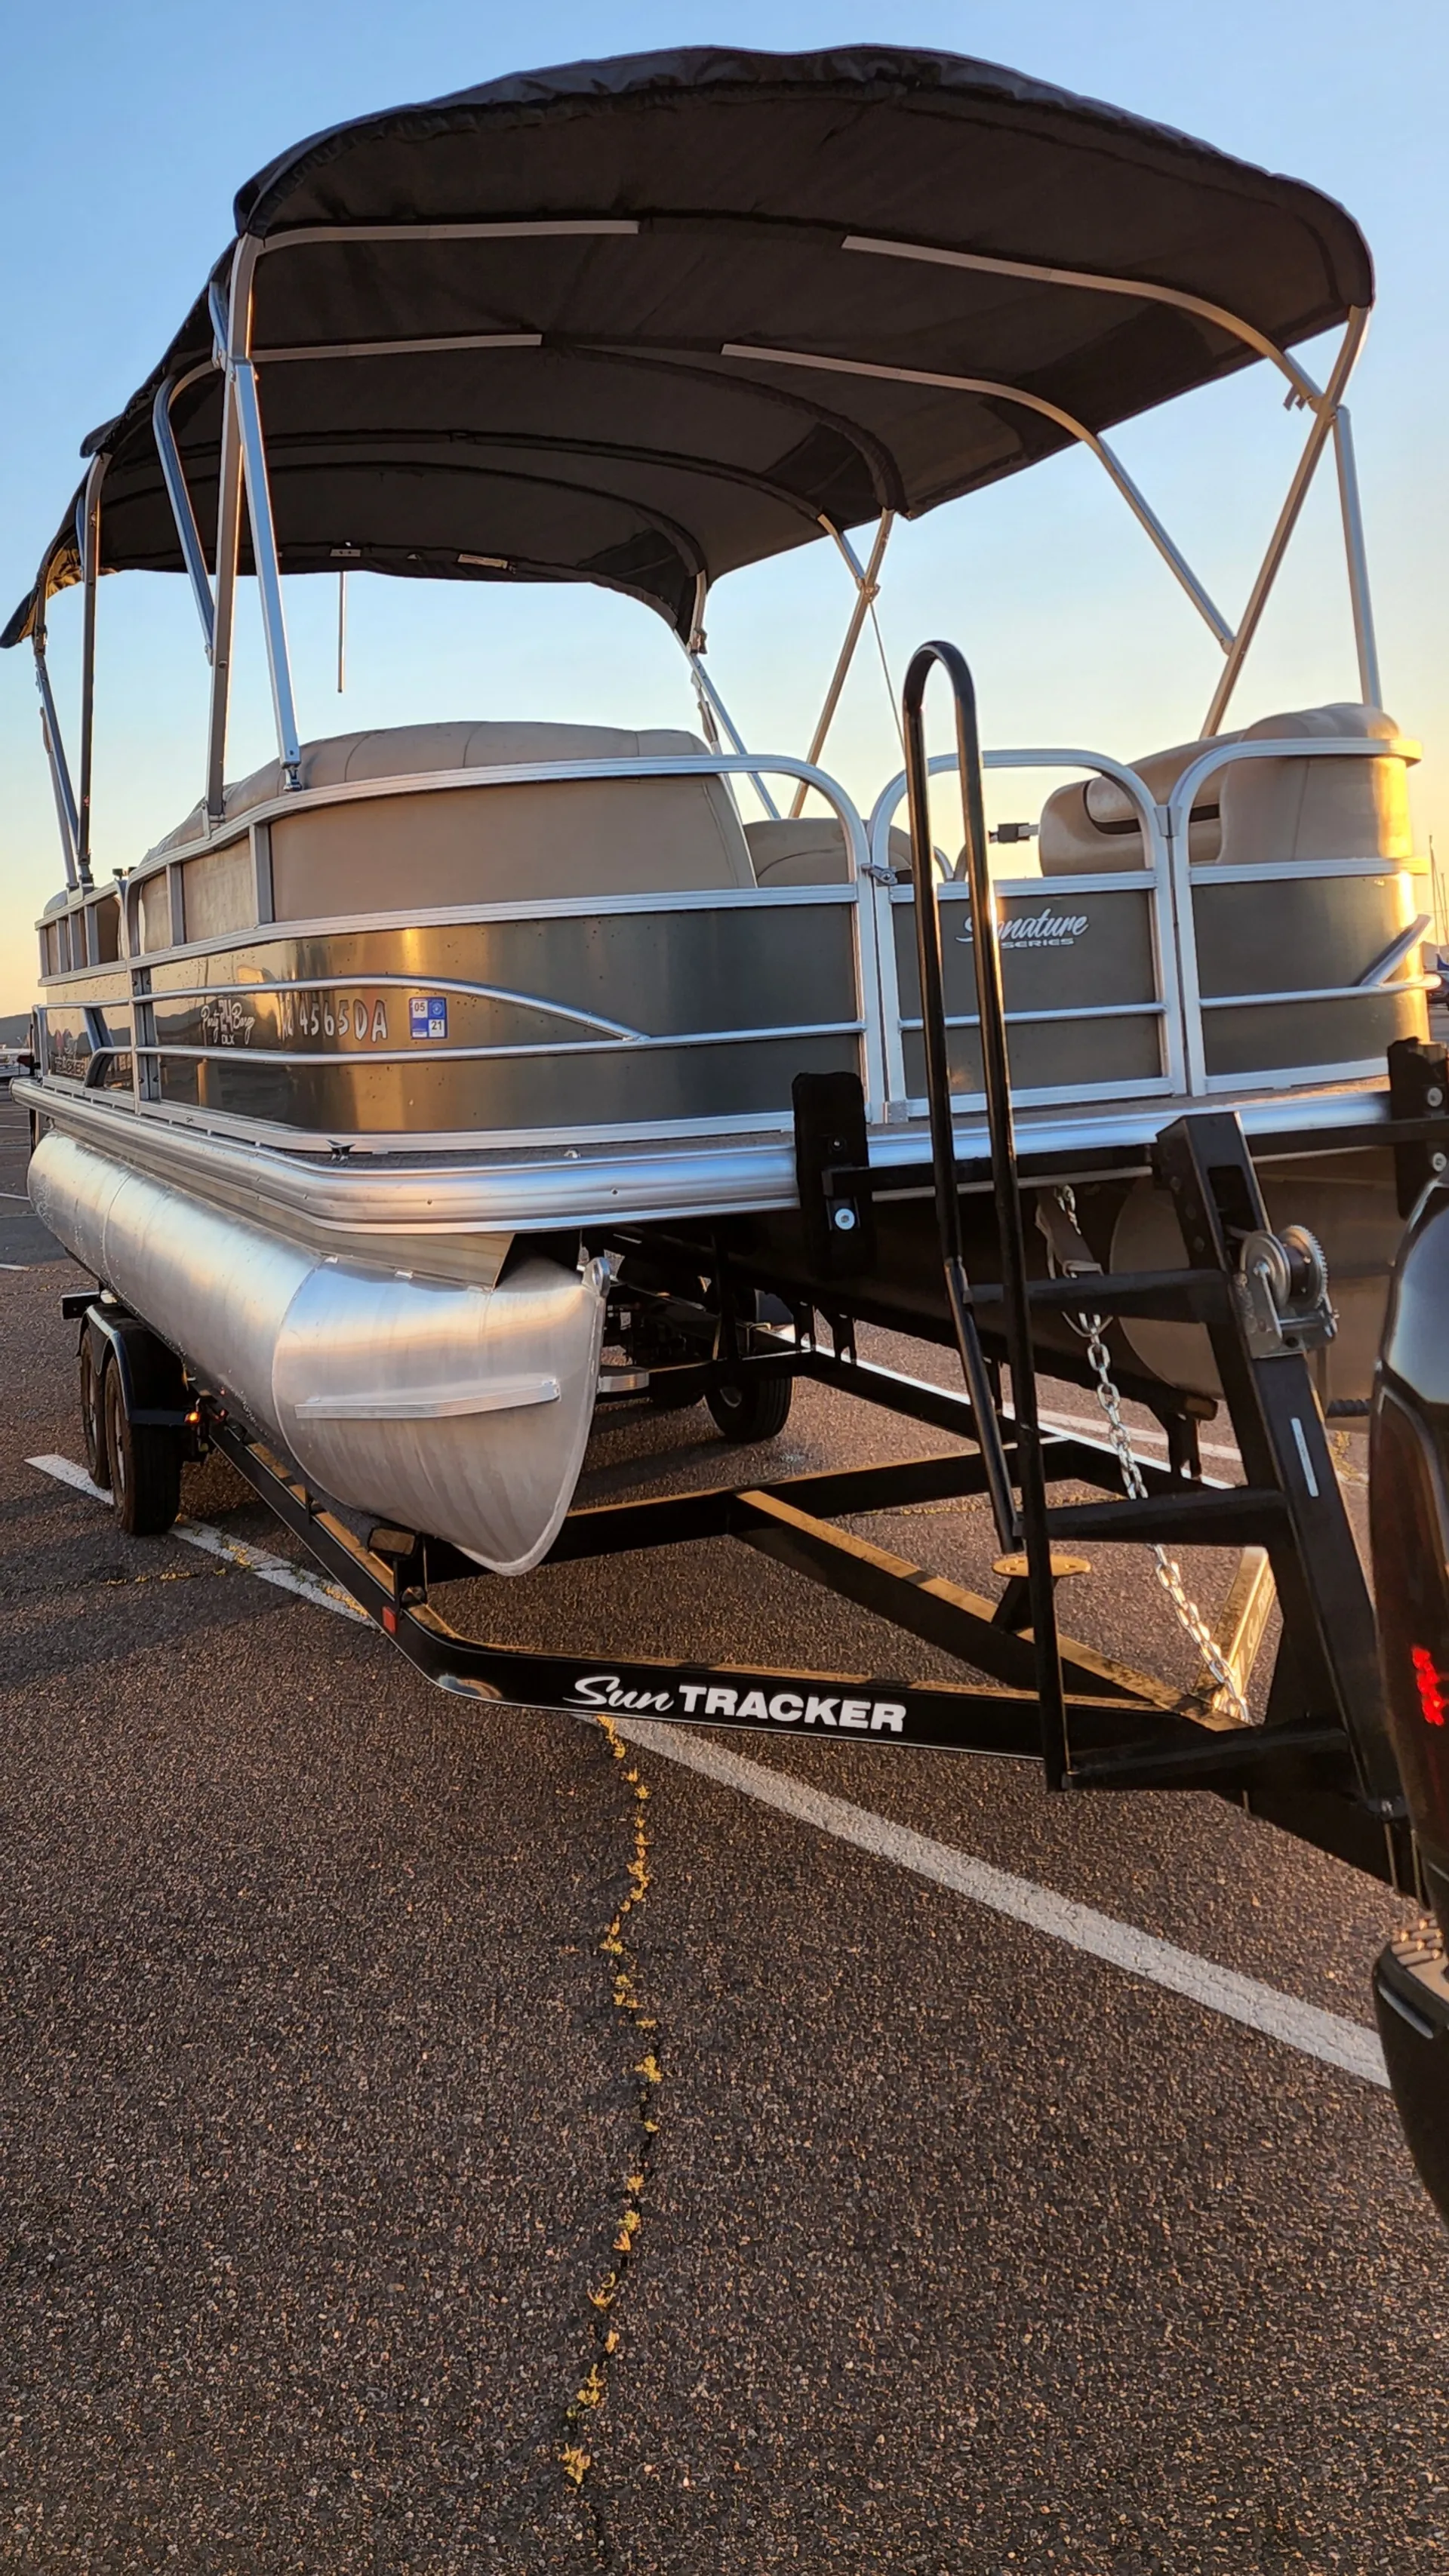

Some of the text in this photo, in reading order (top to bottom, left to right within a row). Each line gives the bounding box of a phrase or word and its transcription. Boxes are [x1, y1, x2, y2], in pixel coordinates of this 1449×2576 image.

[1001, 938, 1075, 949] SERIES
[414, 1002, 426, 1012] 05
[431, 1020, 441, 1030] 21
[221, 1034, 235, 1045] DLX
[562, 1676, 906, 1732] Sun TRACKER
